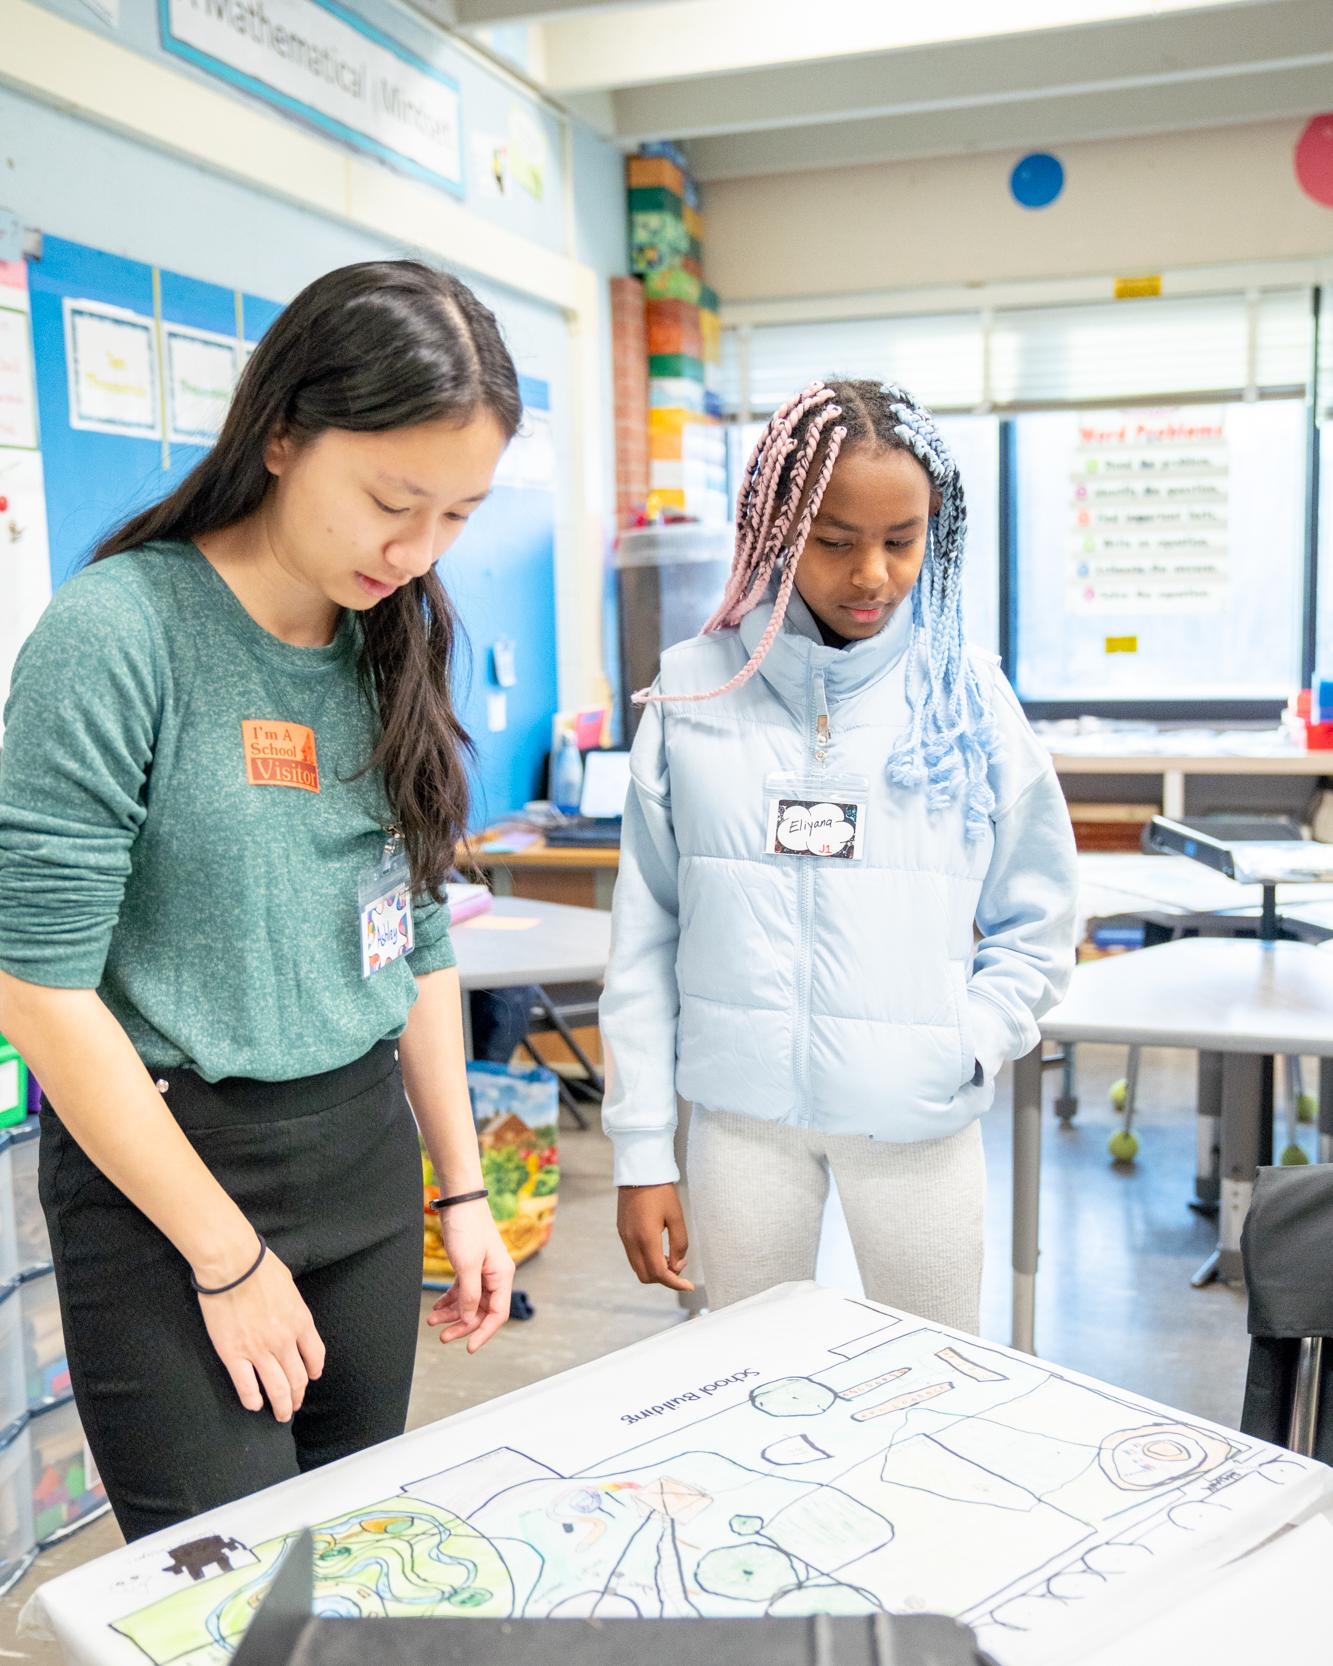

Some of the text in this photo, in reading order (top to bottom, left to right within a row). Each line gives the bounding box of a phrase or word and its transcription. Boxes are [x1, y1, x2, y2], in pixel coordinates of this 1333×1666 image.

[252, 726, 293, 743] I'm A
[250, 742, 297, 758] School
[255, 759, 316, 786] Visitor
[788, 818, 833, 837] Eliyana
[620, 1367, 761, 1426] School Building
